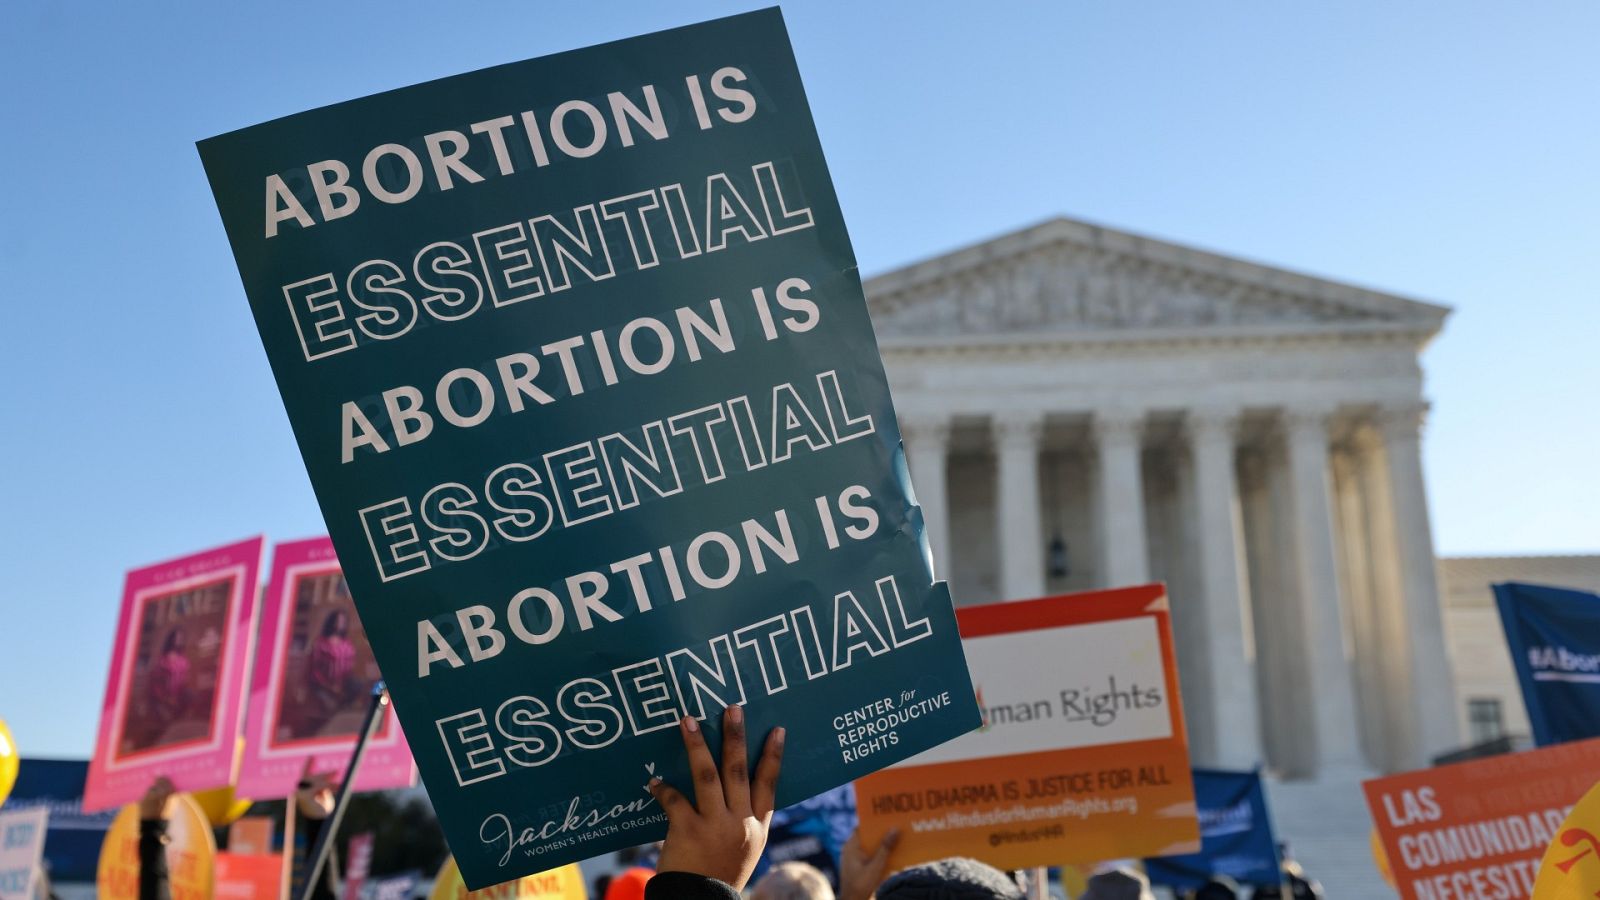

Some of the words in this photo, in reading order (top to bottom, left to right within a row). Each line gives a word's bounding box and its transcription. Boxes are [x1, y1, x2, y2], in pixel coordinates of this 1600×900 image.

[265, 84, 670, 239] ABORTION
[686, 66, 757, 130] IS
[282, 161, 816, 363] ESSENTIAL
[340, 297, 737, 464] ABORTION
[752, 277, 821, 341] IS
[358, 369, 876, 583] ESSENTIAL
[416, 508, 801, 678] ABORTION
[815, 484, 880, 550] IS
[435, 574, 933, 787] ESSENTIAL
[833, 697, 895, 730] CENTER
[898, 689, 916, 708] for
[982, 698, 1053, 727] man
[1059, 674, 1163, 727] Rights
[837, 691, 951, 748] REPRODUCTIVE
[842, 731, 899, 764] RIGHTS
[871, 790, 923, 815] HINDU
[926, 783, 999, 811] DHARMA
[1002, 780, 1021, 801] IS
[1024, 772, 1095, 799] JUSTICE
[1098, 767, 1135, 791] FOR
[1138, 764, 1171, 786] ALL
[1382, 785, 1443, 829] LAS
[479, 796, 656, 867] Jackson
[524, 836, 576, 858] WOMEN'S
[578, 824, 619, 843] HEALTH
[1398, 805, 1575, 871] COMUNIDAD
[1412, 858, 1542, 900] NECESIT
